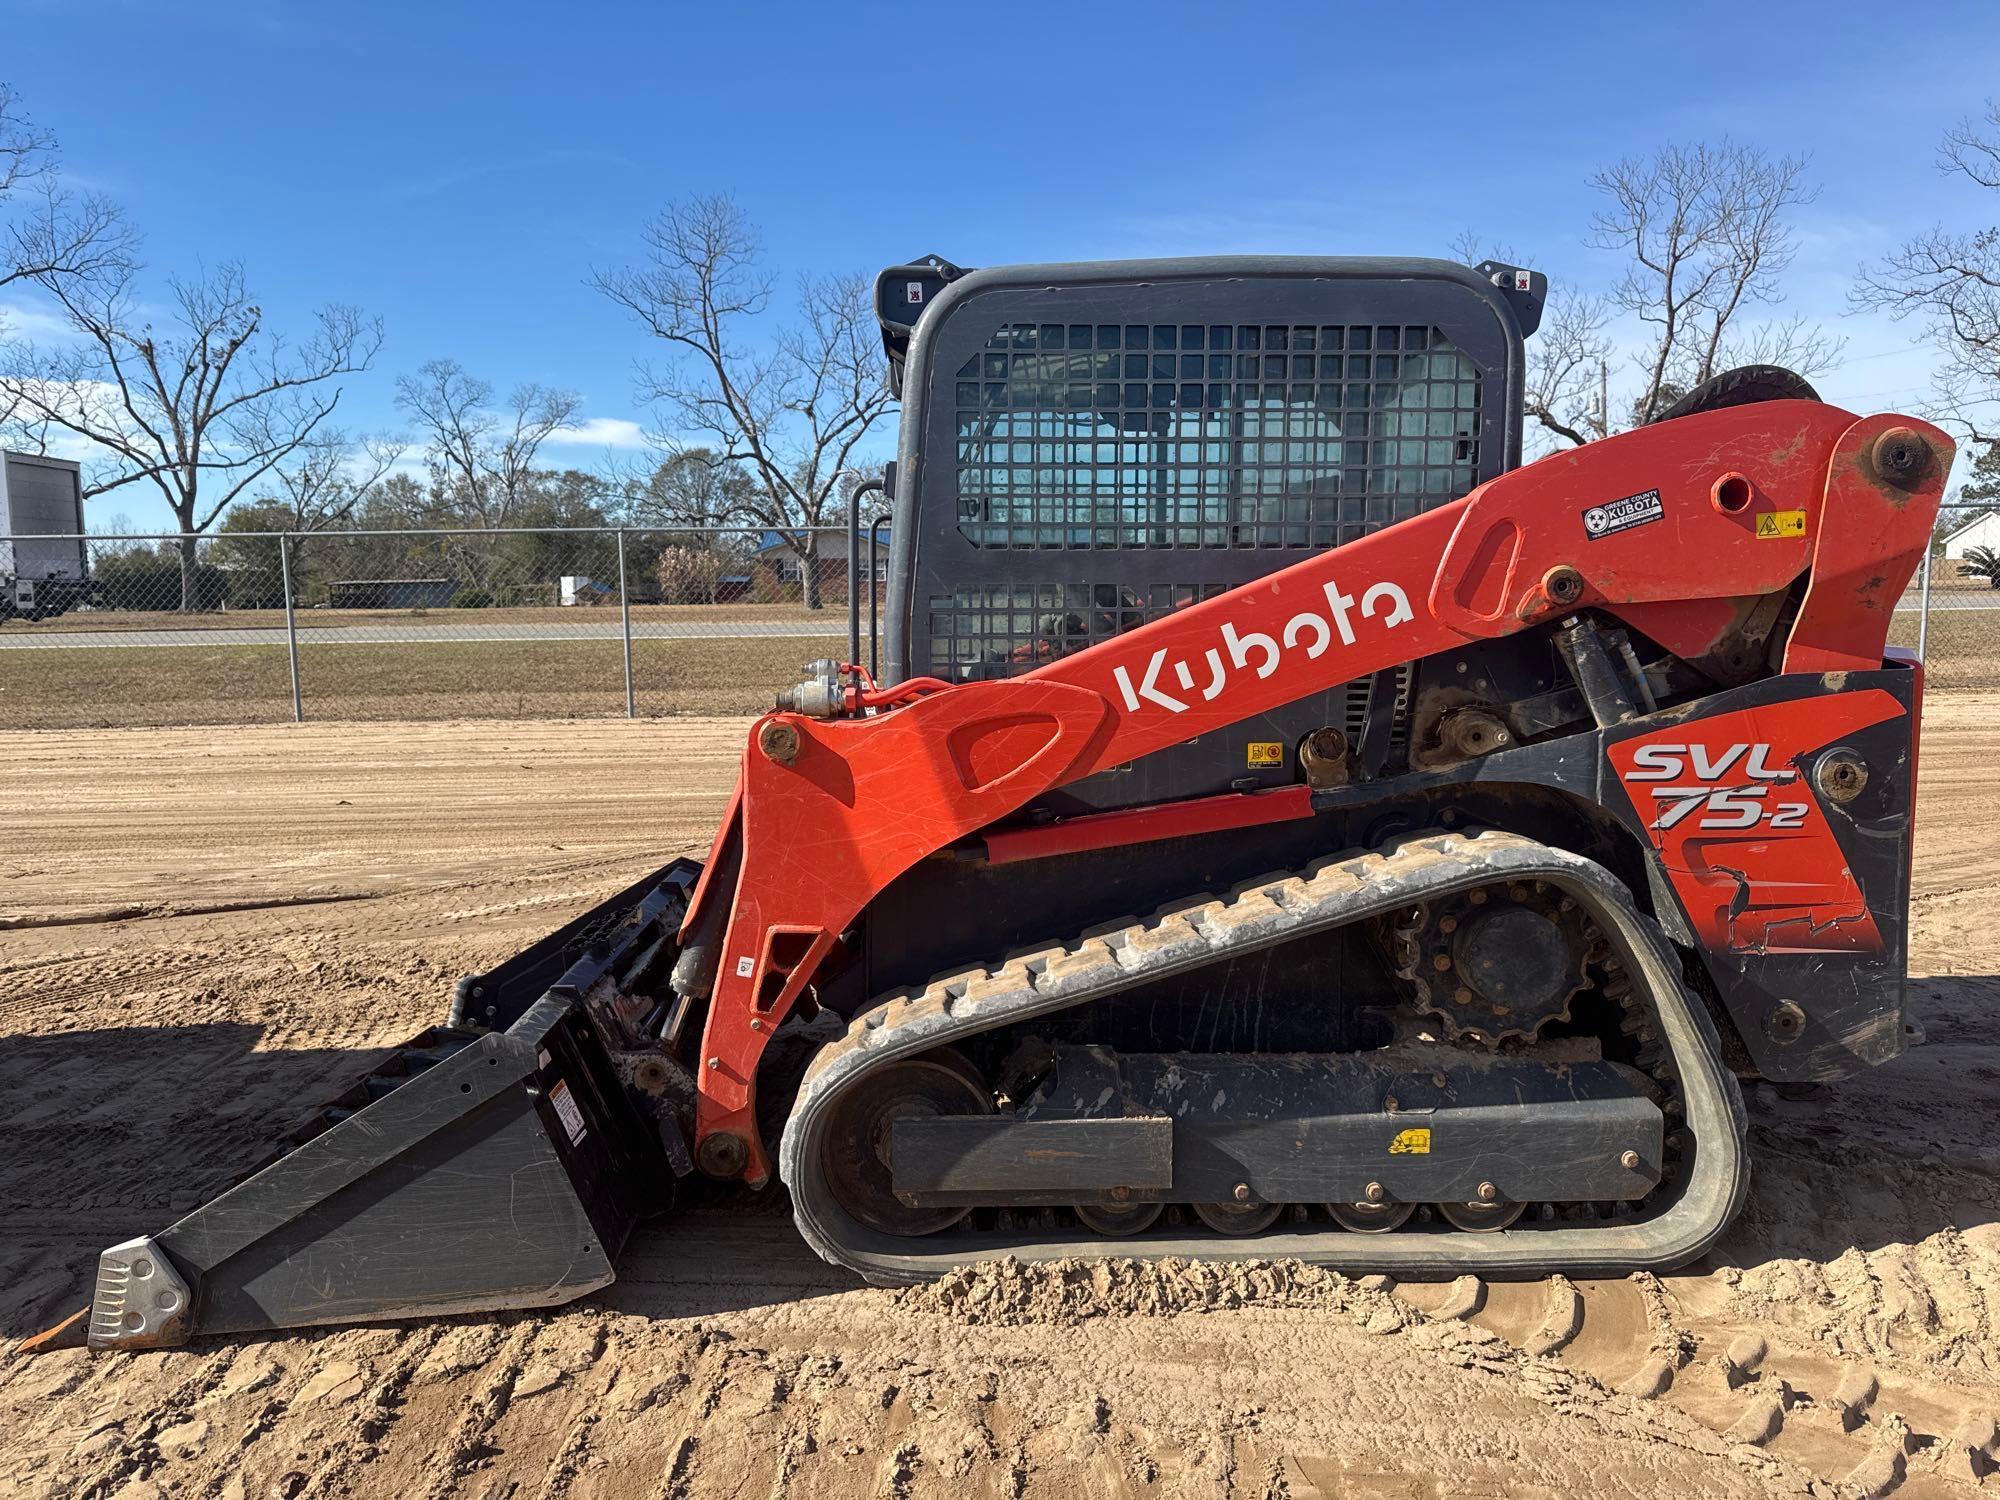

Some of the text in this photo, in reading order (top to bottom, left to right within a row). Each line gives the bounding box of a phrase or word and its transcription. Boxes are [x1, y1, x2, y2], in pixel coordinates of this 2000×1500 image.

[1604, 490, 1658, 511] GREENE COUNTY
[1608, 496, 1660, 519] KUBOTA
[1623, 508, 1655, 521] EQUIPMENT
[1113, 580, 1415, 713] Kubota
[1624, 743, 1796, 780] SVL
[1649, 786, 1809, 828] 75-2
